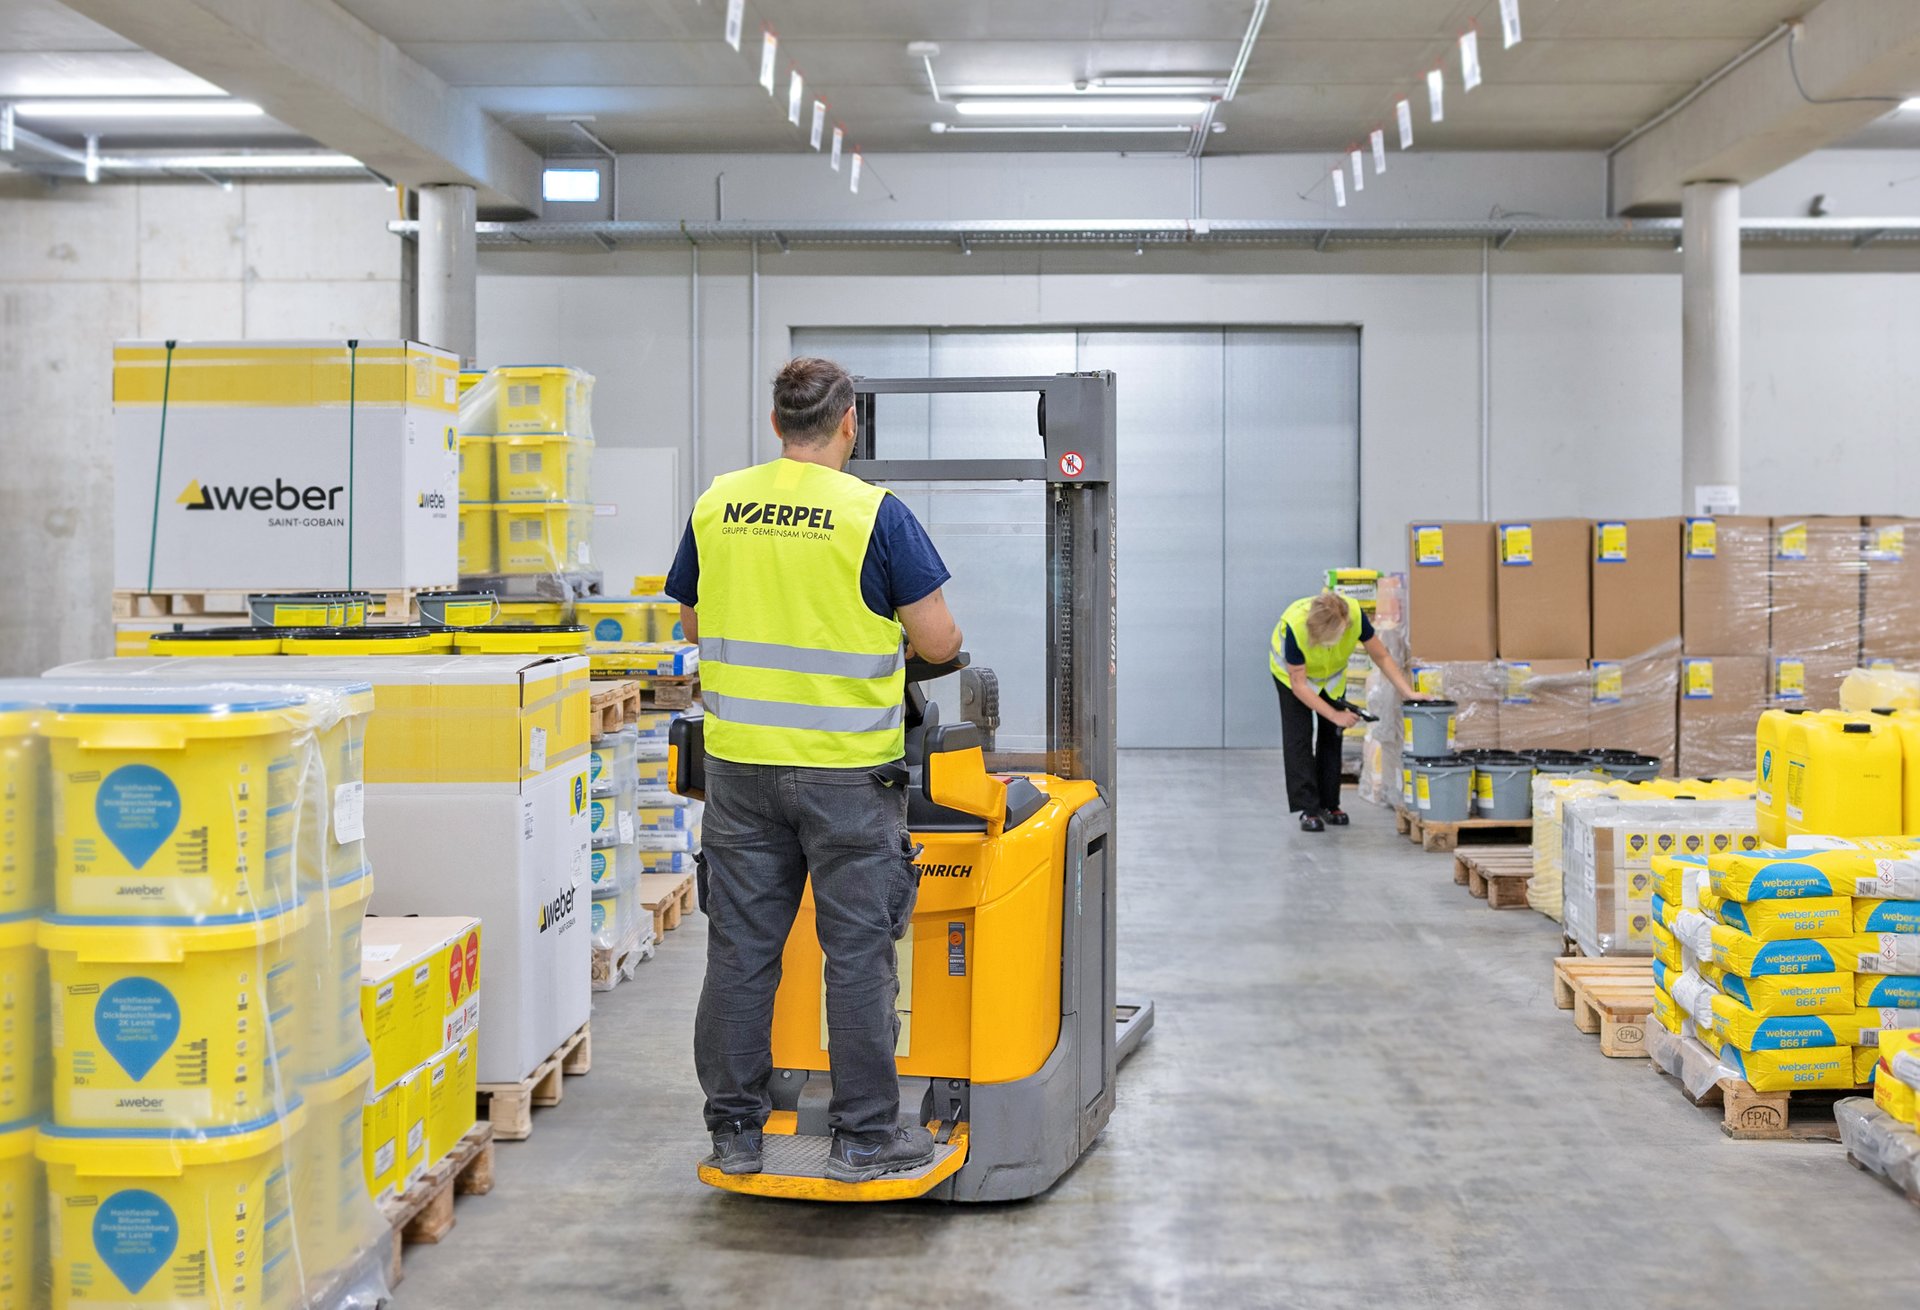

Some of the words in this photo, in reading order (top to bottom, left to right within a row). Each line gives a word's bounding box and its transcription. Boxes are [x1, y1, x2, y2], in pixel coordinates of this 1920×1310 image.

[213, 478, 344, 511] weber
[268, 518, 345, 527] SAINT-GOBAIN
[722, 526, 748, 535] GRUPPE
[752, 527, 800, 538] GEMEINSAM
[1762, 878, 1819, 888] weber.xerm
[123, 884, 165, 896] weber
[1776, 889, 1796, 897] 866
[1798, 888, 1805, 896] F
[1778, 909, 1840, 919] weber.xerm
[1794, 921, 1815, 930] 866
[1818, 920, 1825, 929] F
[1765, 954, 1822, 964] weber.xerm
[1779, 965, 1799, 973] 866
[1801, 964, 1808, 972] F
[1780, 985, 1841, 996] weber.xerm
[1796, 998, 1817, 1007] 866
[1819, 997, 1826, 1006] F
[1620, 1029, 1639, 1039] EPAL
[1765, 1028, 1822, 1038] weber.xerm
[1780, 1039, 1800, 1047] 866
[1801, 1038, 1808, 1047] F
[1778, 1061, 1840, 1071] weber.xerm
[1794, 1073, 1815, 1082] 866
[1817, 1072, 1824, 1080] F
[122, 1096, 164, 1108] weber
